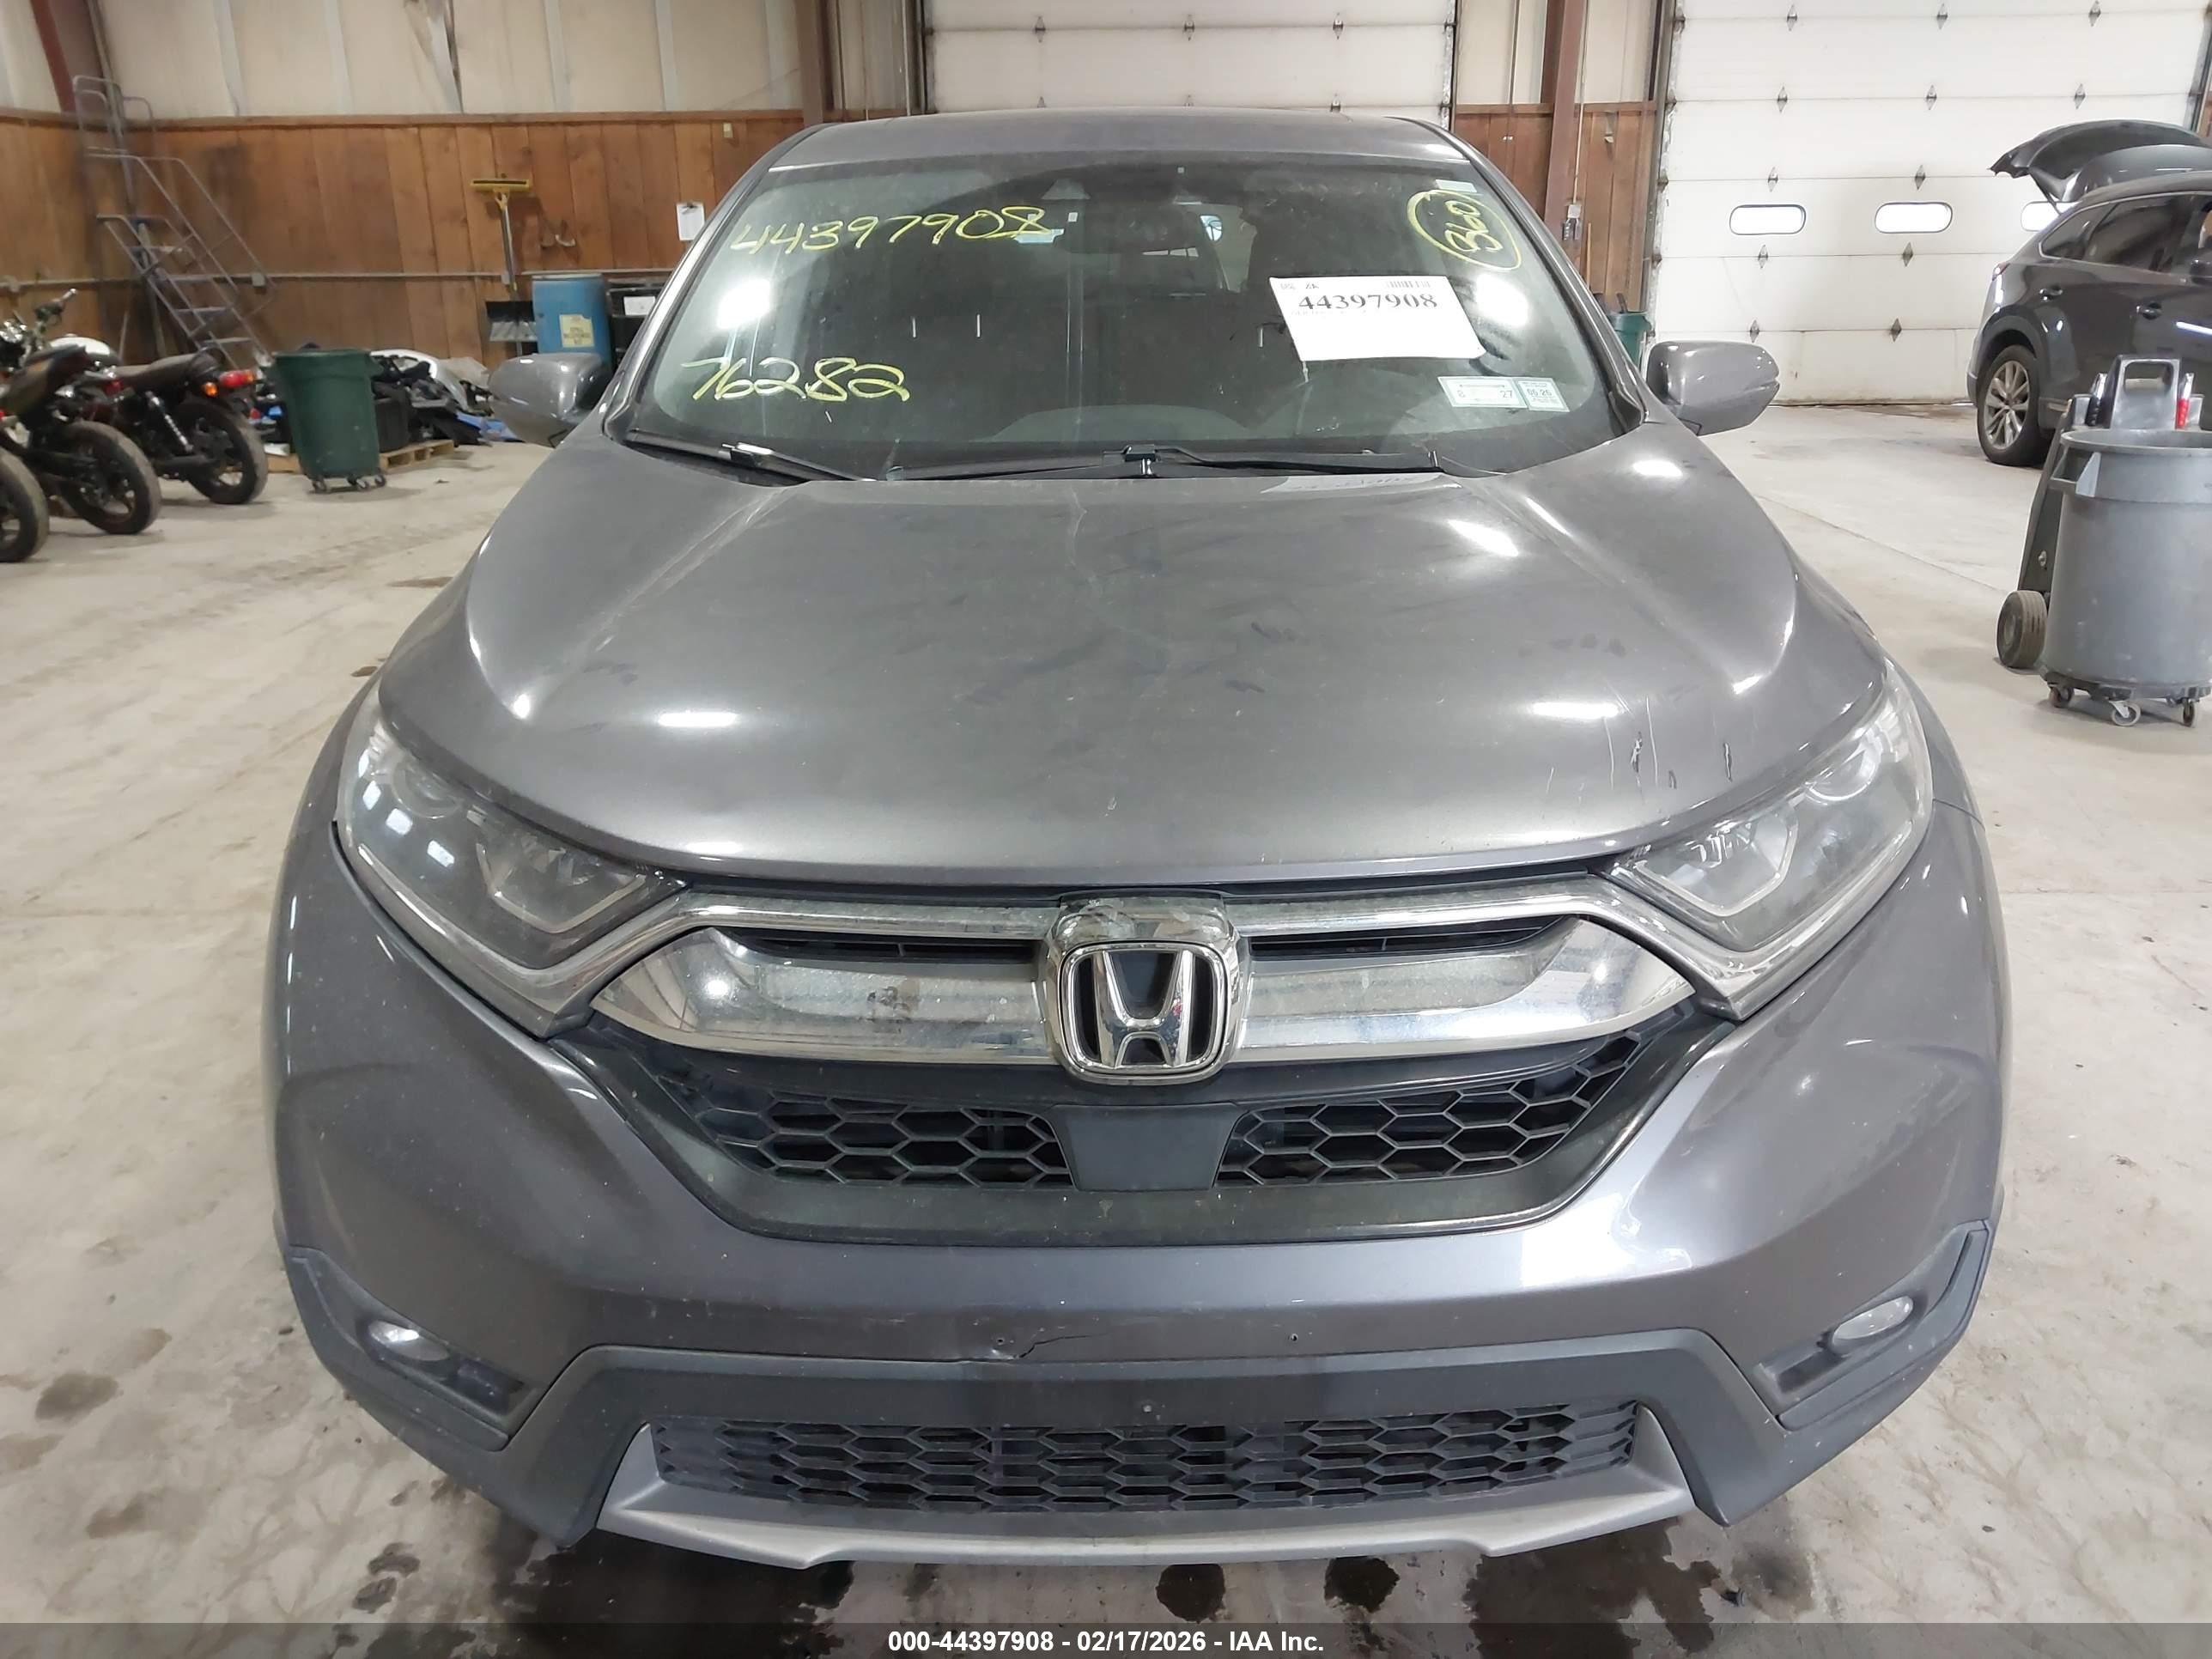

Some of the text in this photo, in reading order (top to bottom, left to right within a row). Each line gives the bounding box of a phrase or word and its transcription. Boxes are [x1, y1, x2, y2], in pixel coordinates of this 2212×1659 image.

[730, 205, 1054, 254] 44397908
[1298, 294, 1438, 310] 44397908
[681, 356, 911, 402] 76282
